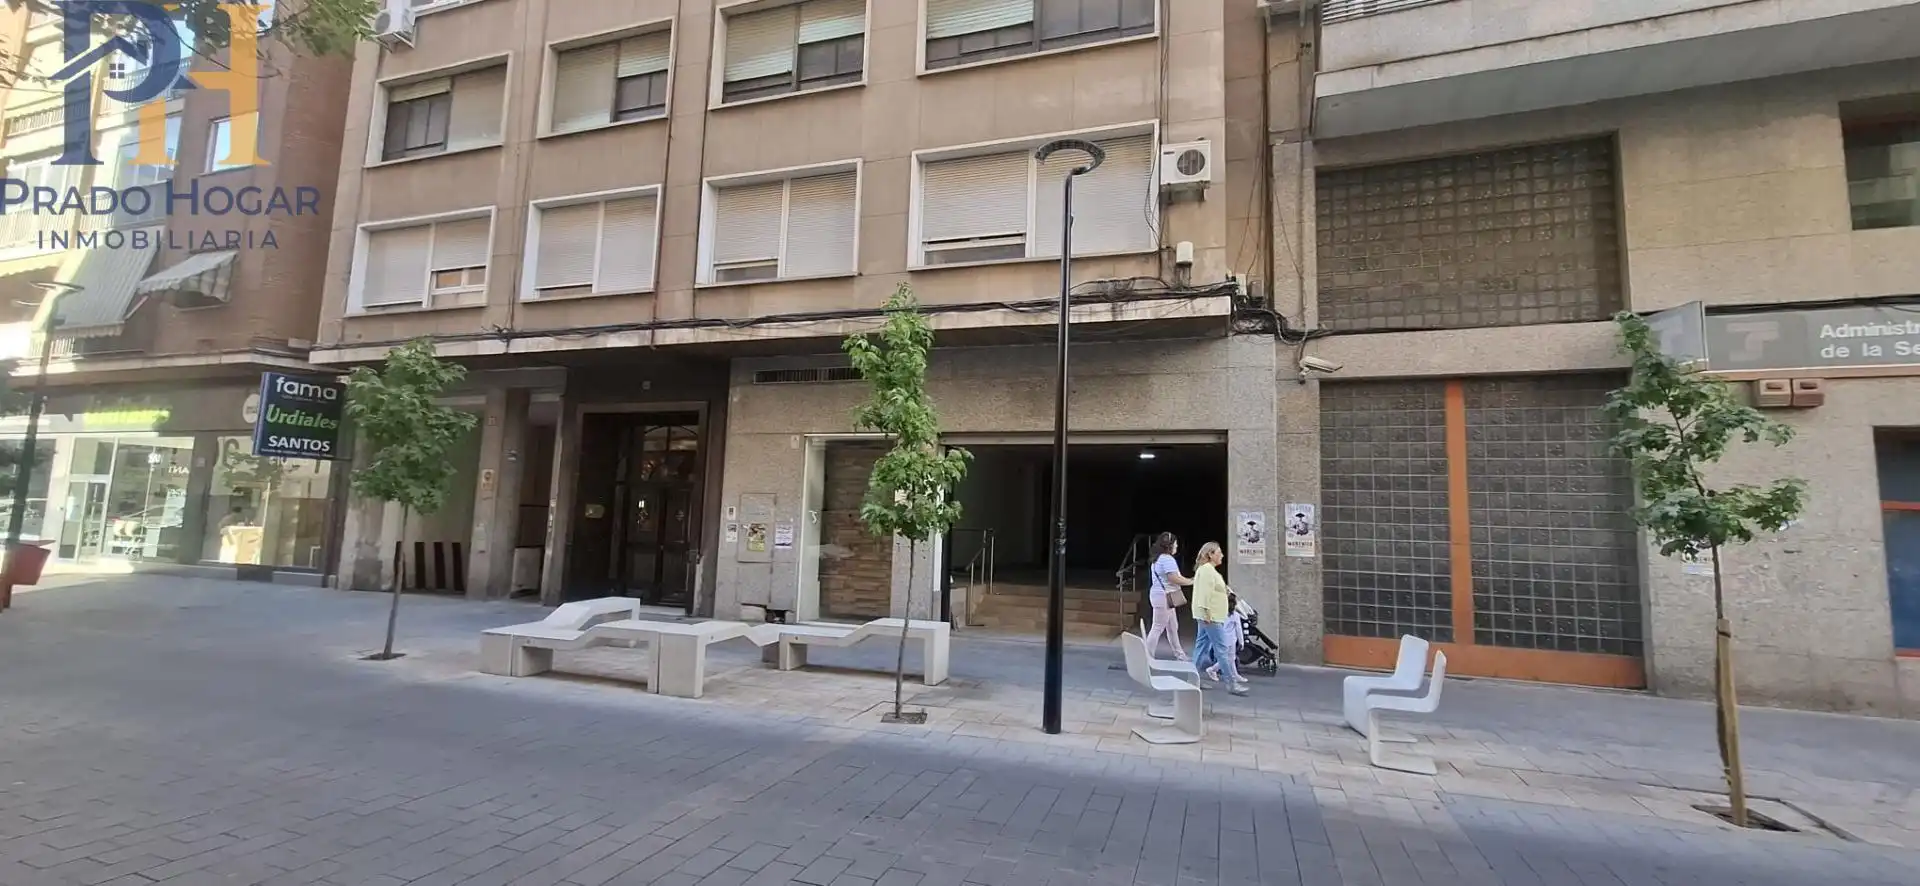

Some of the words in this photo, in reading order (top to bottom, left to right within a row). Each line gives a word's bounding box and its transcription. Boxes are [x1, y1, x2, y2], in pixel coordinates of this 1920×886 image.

[1820, 343, 1850, 358] de
[1862, 342, 1882, 357] la
[276, 376, 337, 400] fama
[265, 403, 339, 429] Urdiales
[268, 435, 331, 452] SANTOS
